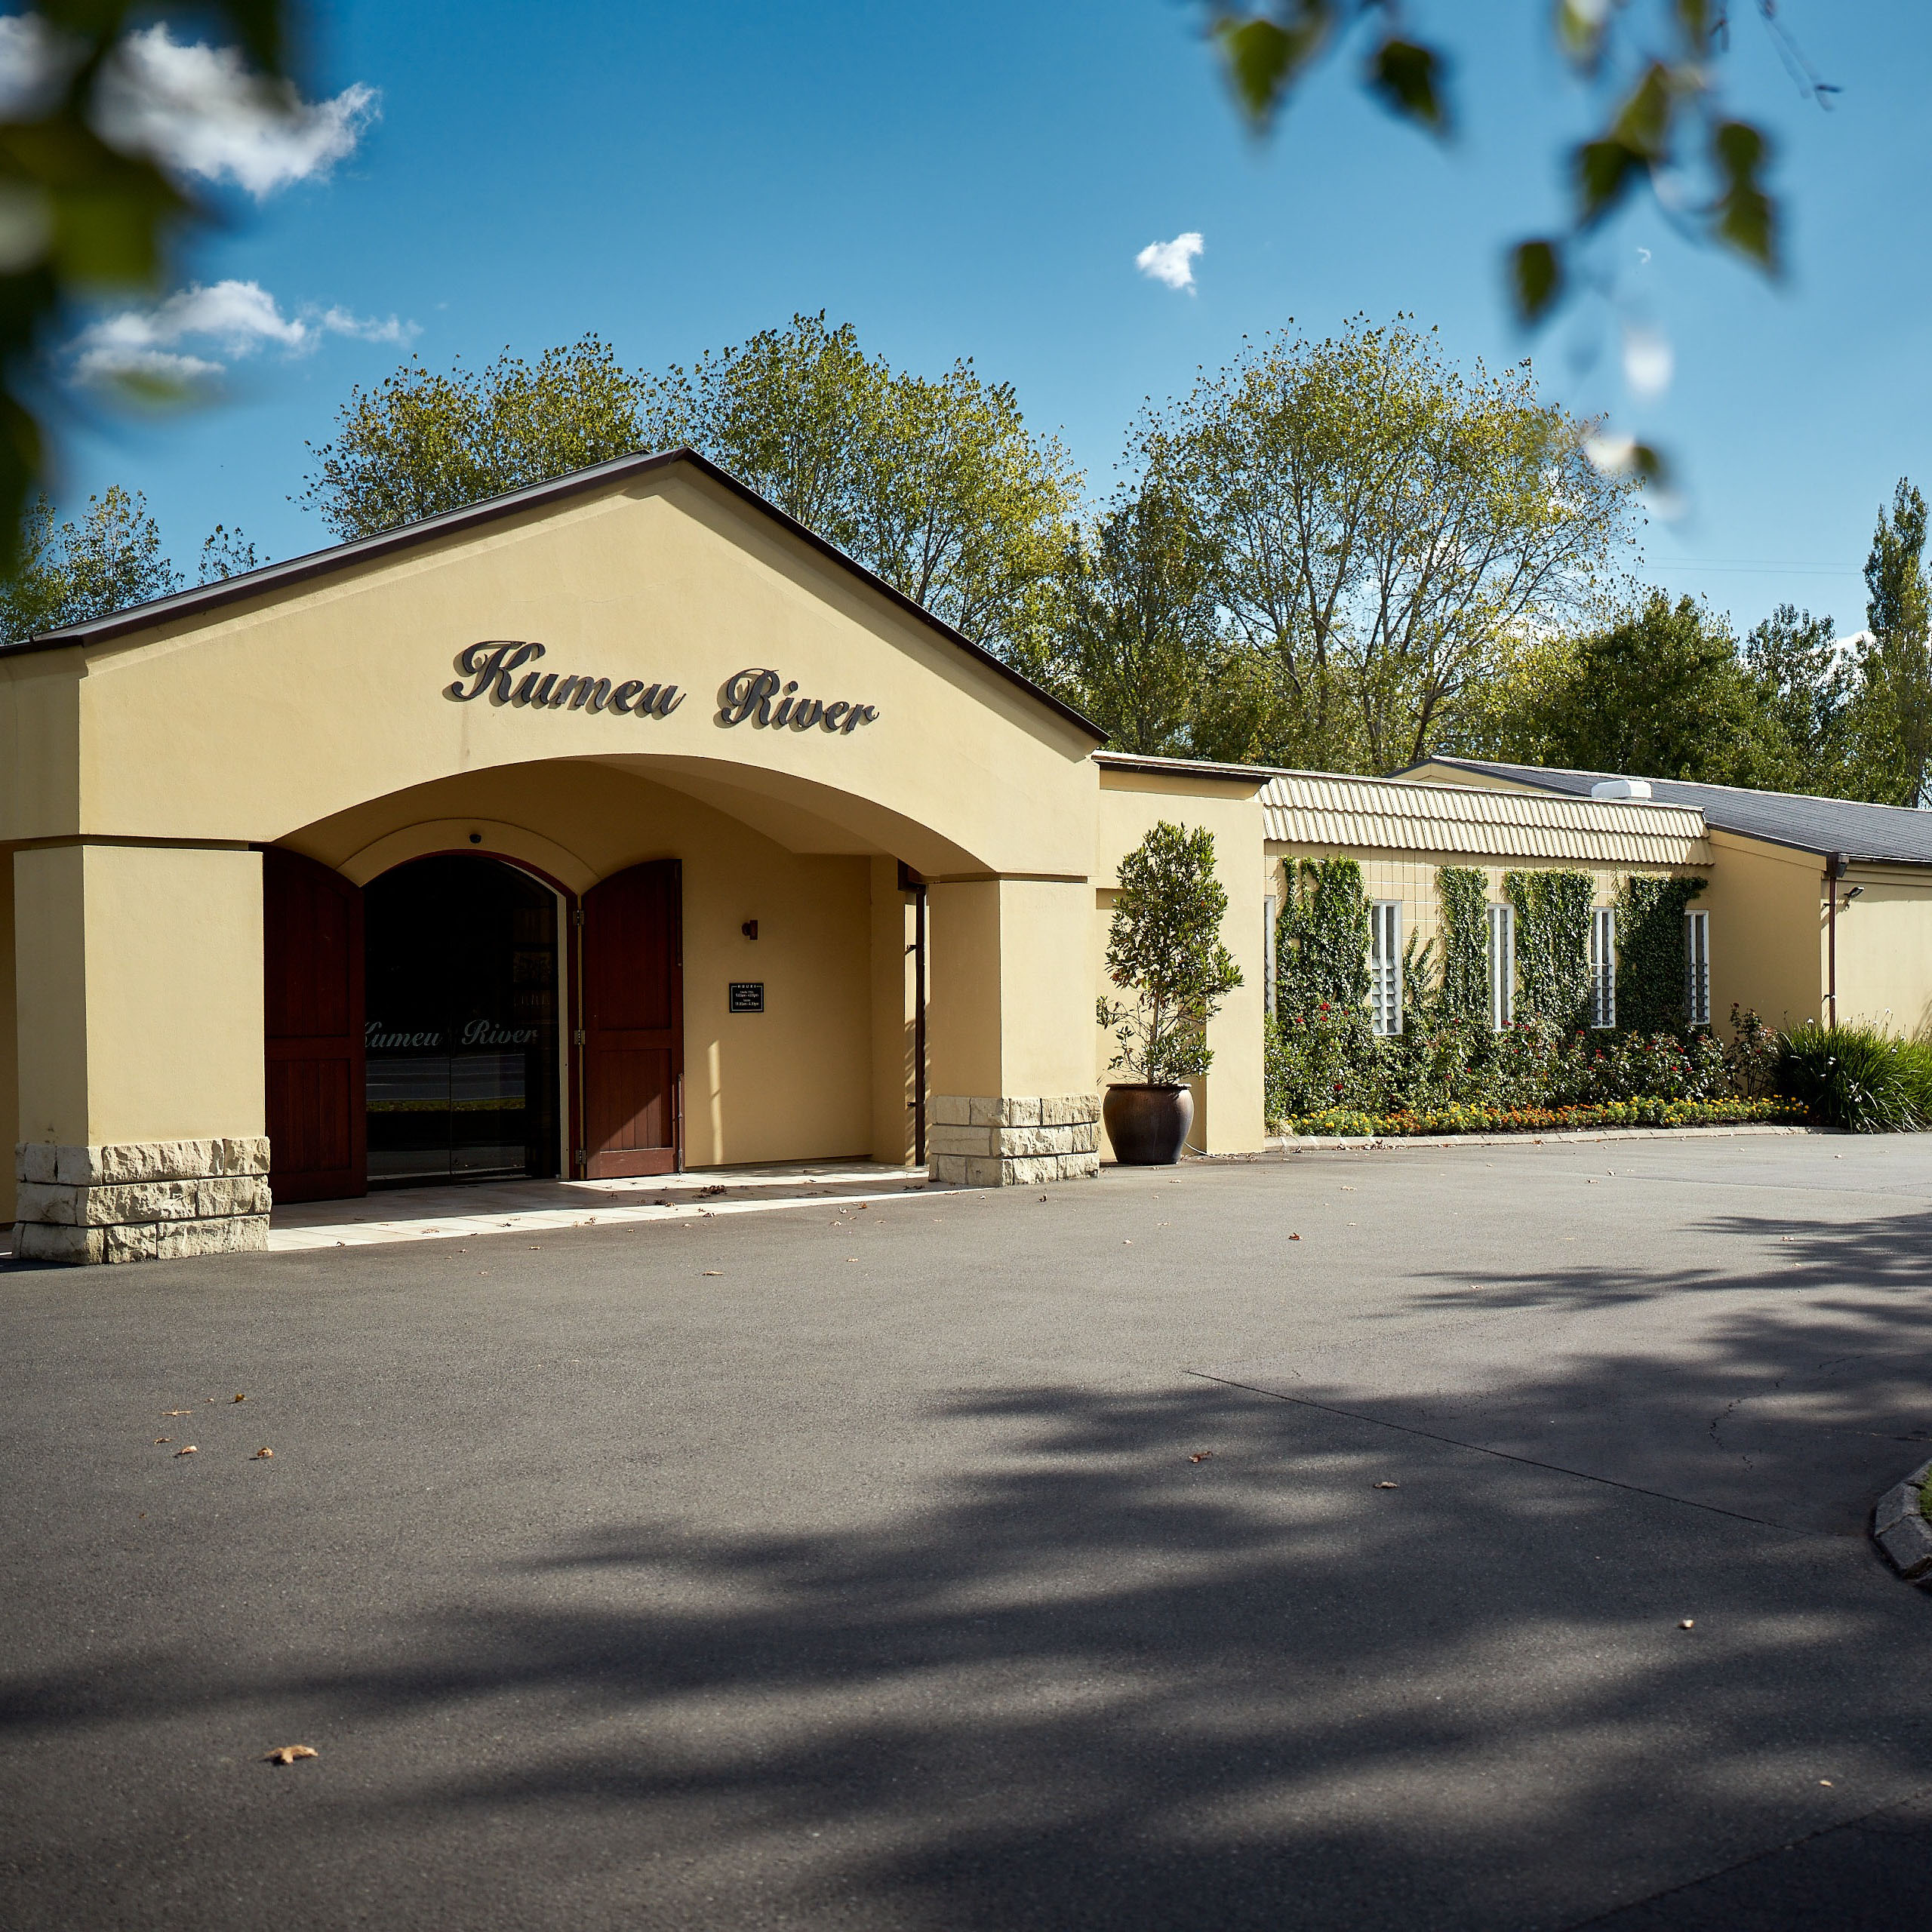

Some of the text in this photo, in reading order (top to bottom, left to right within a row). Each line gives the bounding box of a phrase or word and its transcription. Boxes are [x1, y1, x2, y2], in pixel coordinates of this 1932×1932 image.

[451, 639, 879, 735] Kumeu River
[461, 1019, 538, 1045] River
